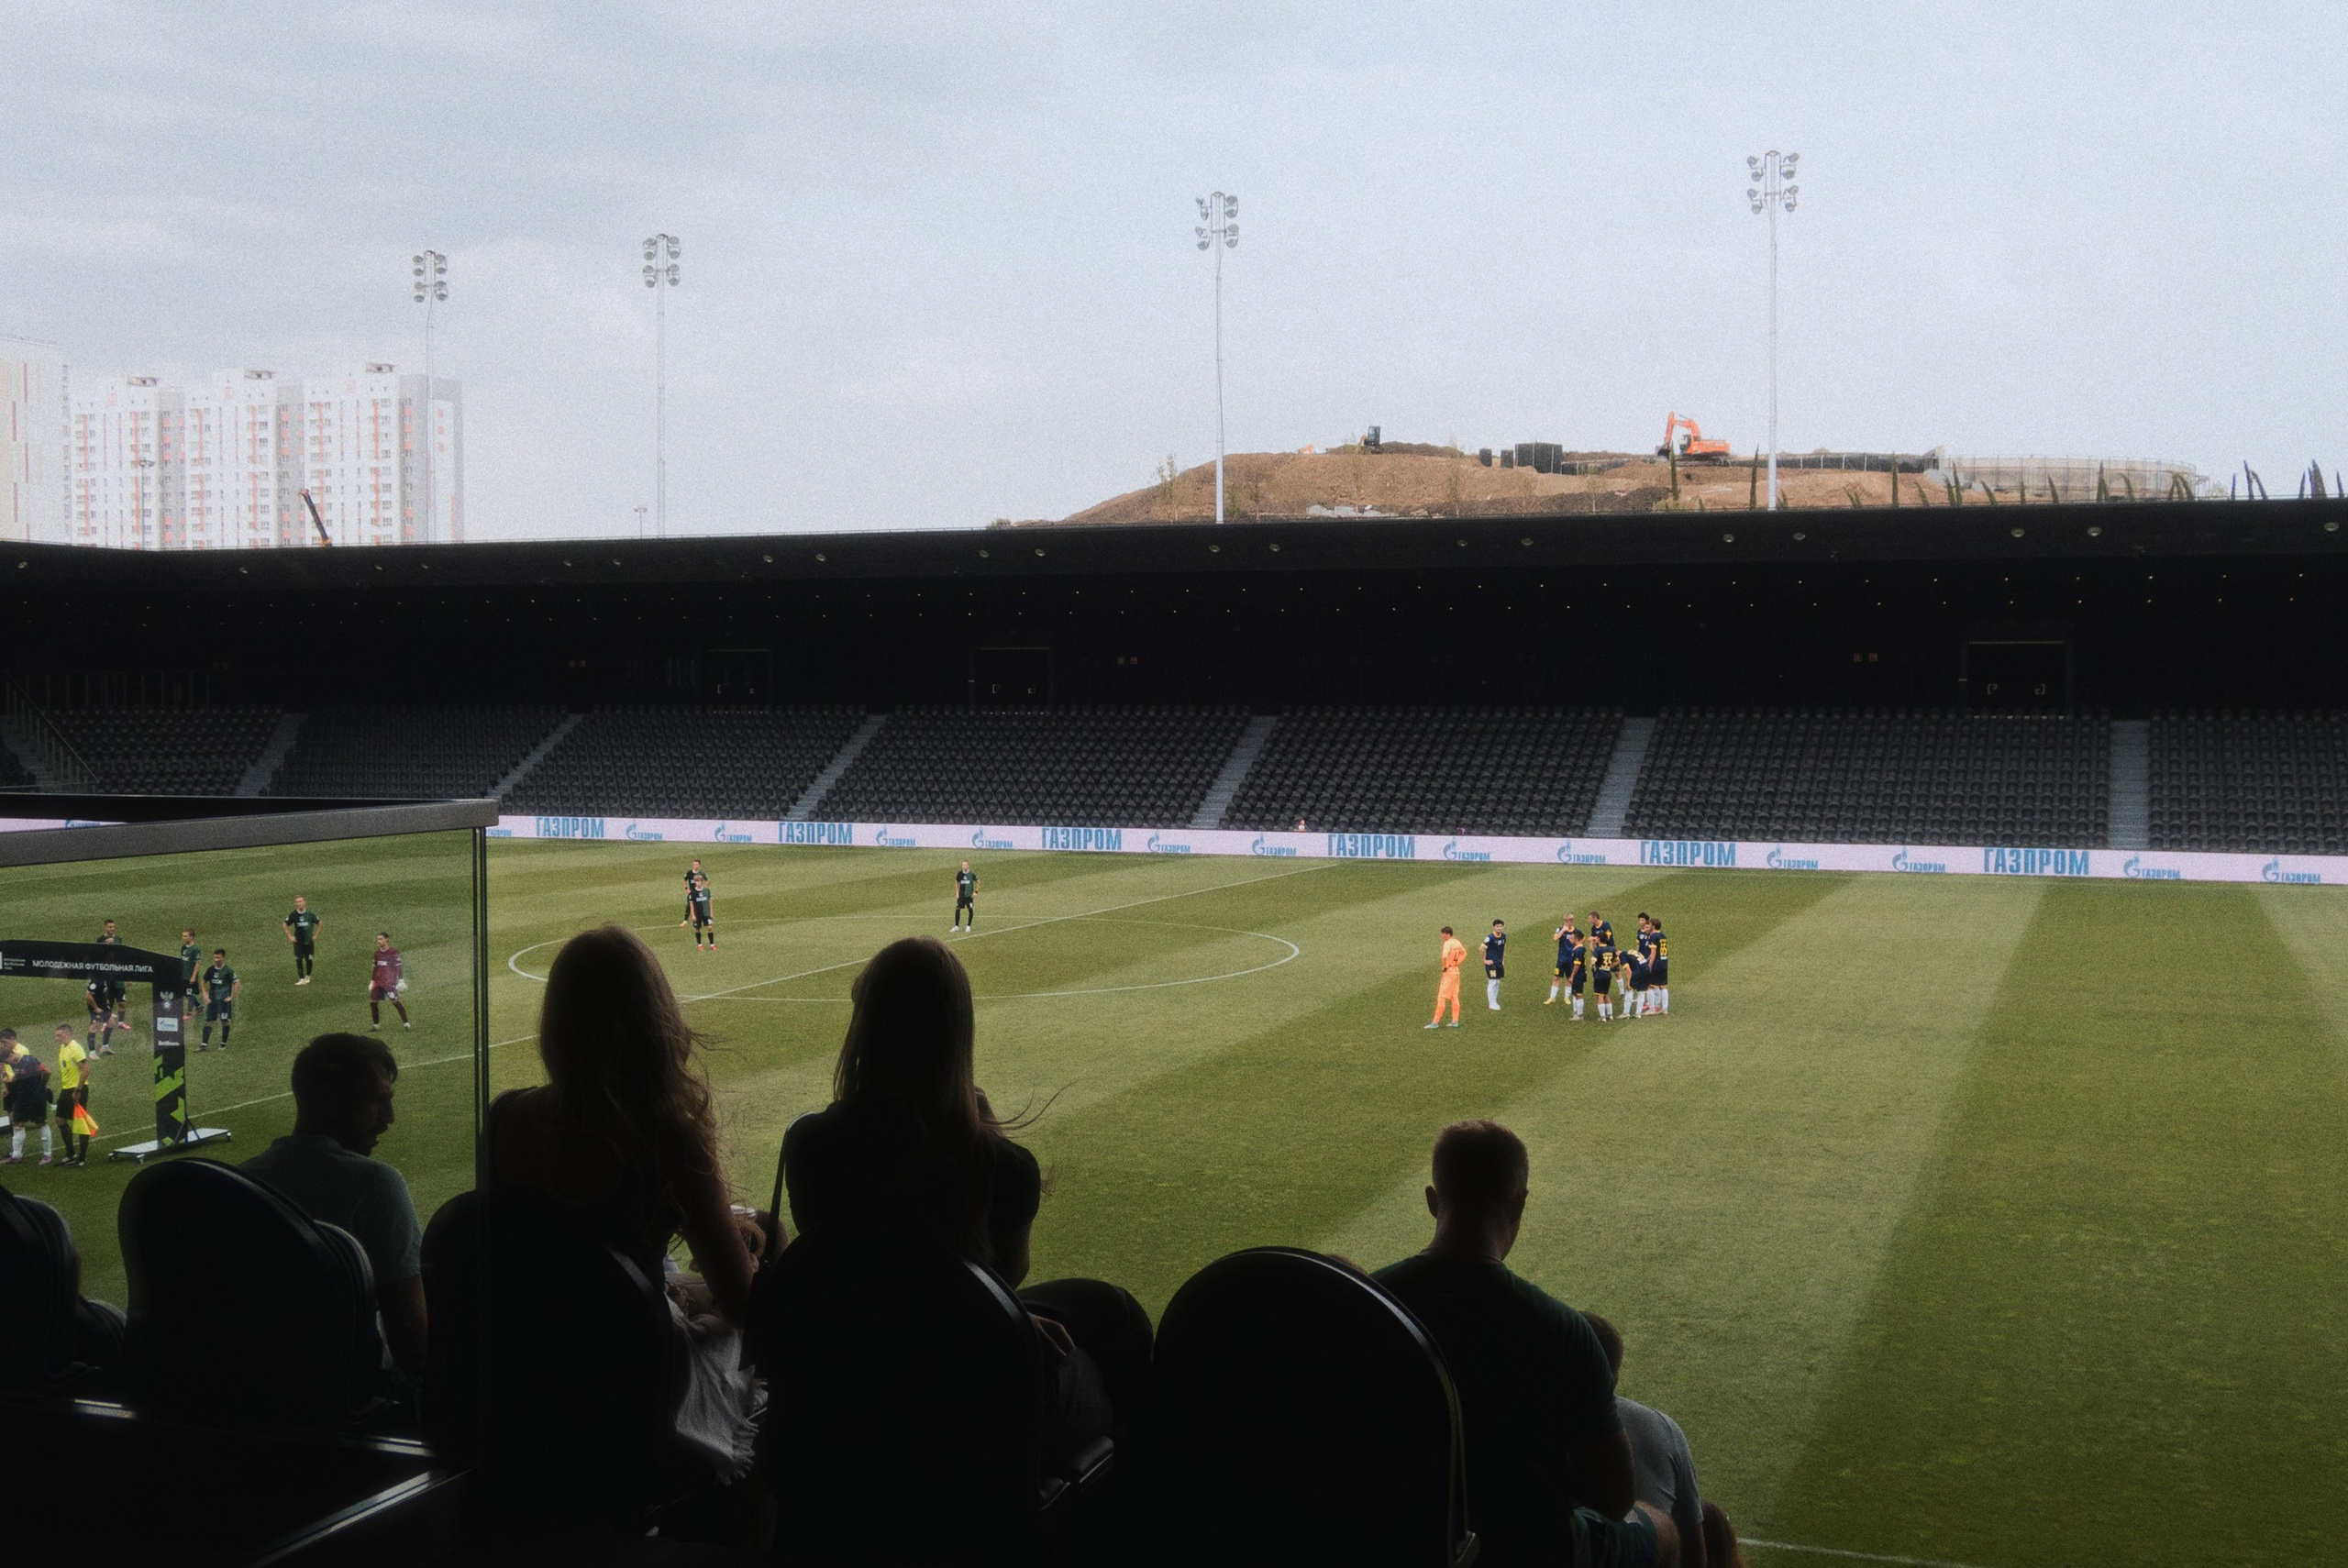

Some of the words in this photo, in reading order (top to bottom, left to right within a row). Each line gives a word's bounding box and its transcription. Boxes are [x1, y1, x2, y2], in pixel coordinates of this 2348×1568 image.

[536, 817, 605, 838] ГАЗПРОМ
[637, 832, 663, 841] ГАЗПРОМ
[778, 822, 853, 844] ГАЗПРОМ
[726, 834, 752, 843] ГАЗПРОМ
[888, 838, 915, 846] ГАЗПРОМ
[1041, 827, 1122, 850] ГАЗПРОМ
[985, 840, 1013, 848] ГАЗПРОМ
[1161, 845, 1191, 853] ГАЗПРОМ
[1327, 834, 1415, 857] ГАЗПРОМ
[1266, 846, 1296, 856] ГАЗПРОМ
[1640, 841, 1736, 866] ГАЗПРОМ
[1457, 852, 1490, 861] ГАЗПРОМ
[1573, 855, 1606, 865] ГАЗПРОМ
[1783, 859, 1819, 869] ГАЗПРОМ
[1910, 862, 1945, 872] ГАЗПРОМ
[1984, 848, 2089, 876] ГАЗПРОМ
[2142, 869, 2180, 879] ГАЗПРОМ
[2281, 872, 2320, 884] ГАЗПРОМ
[32, 960, 84, 969] МОЛОДЕЖНАЯ
[84, 963, 134, 972] ФУТБОЛЬНАЯ
